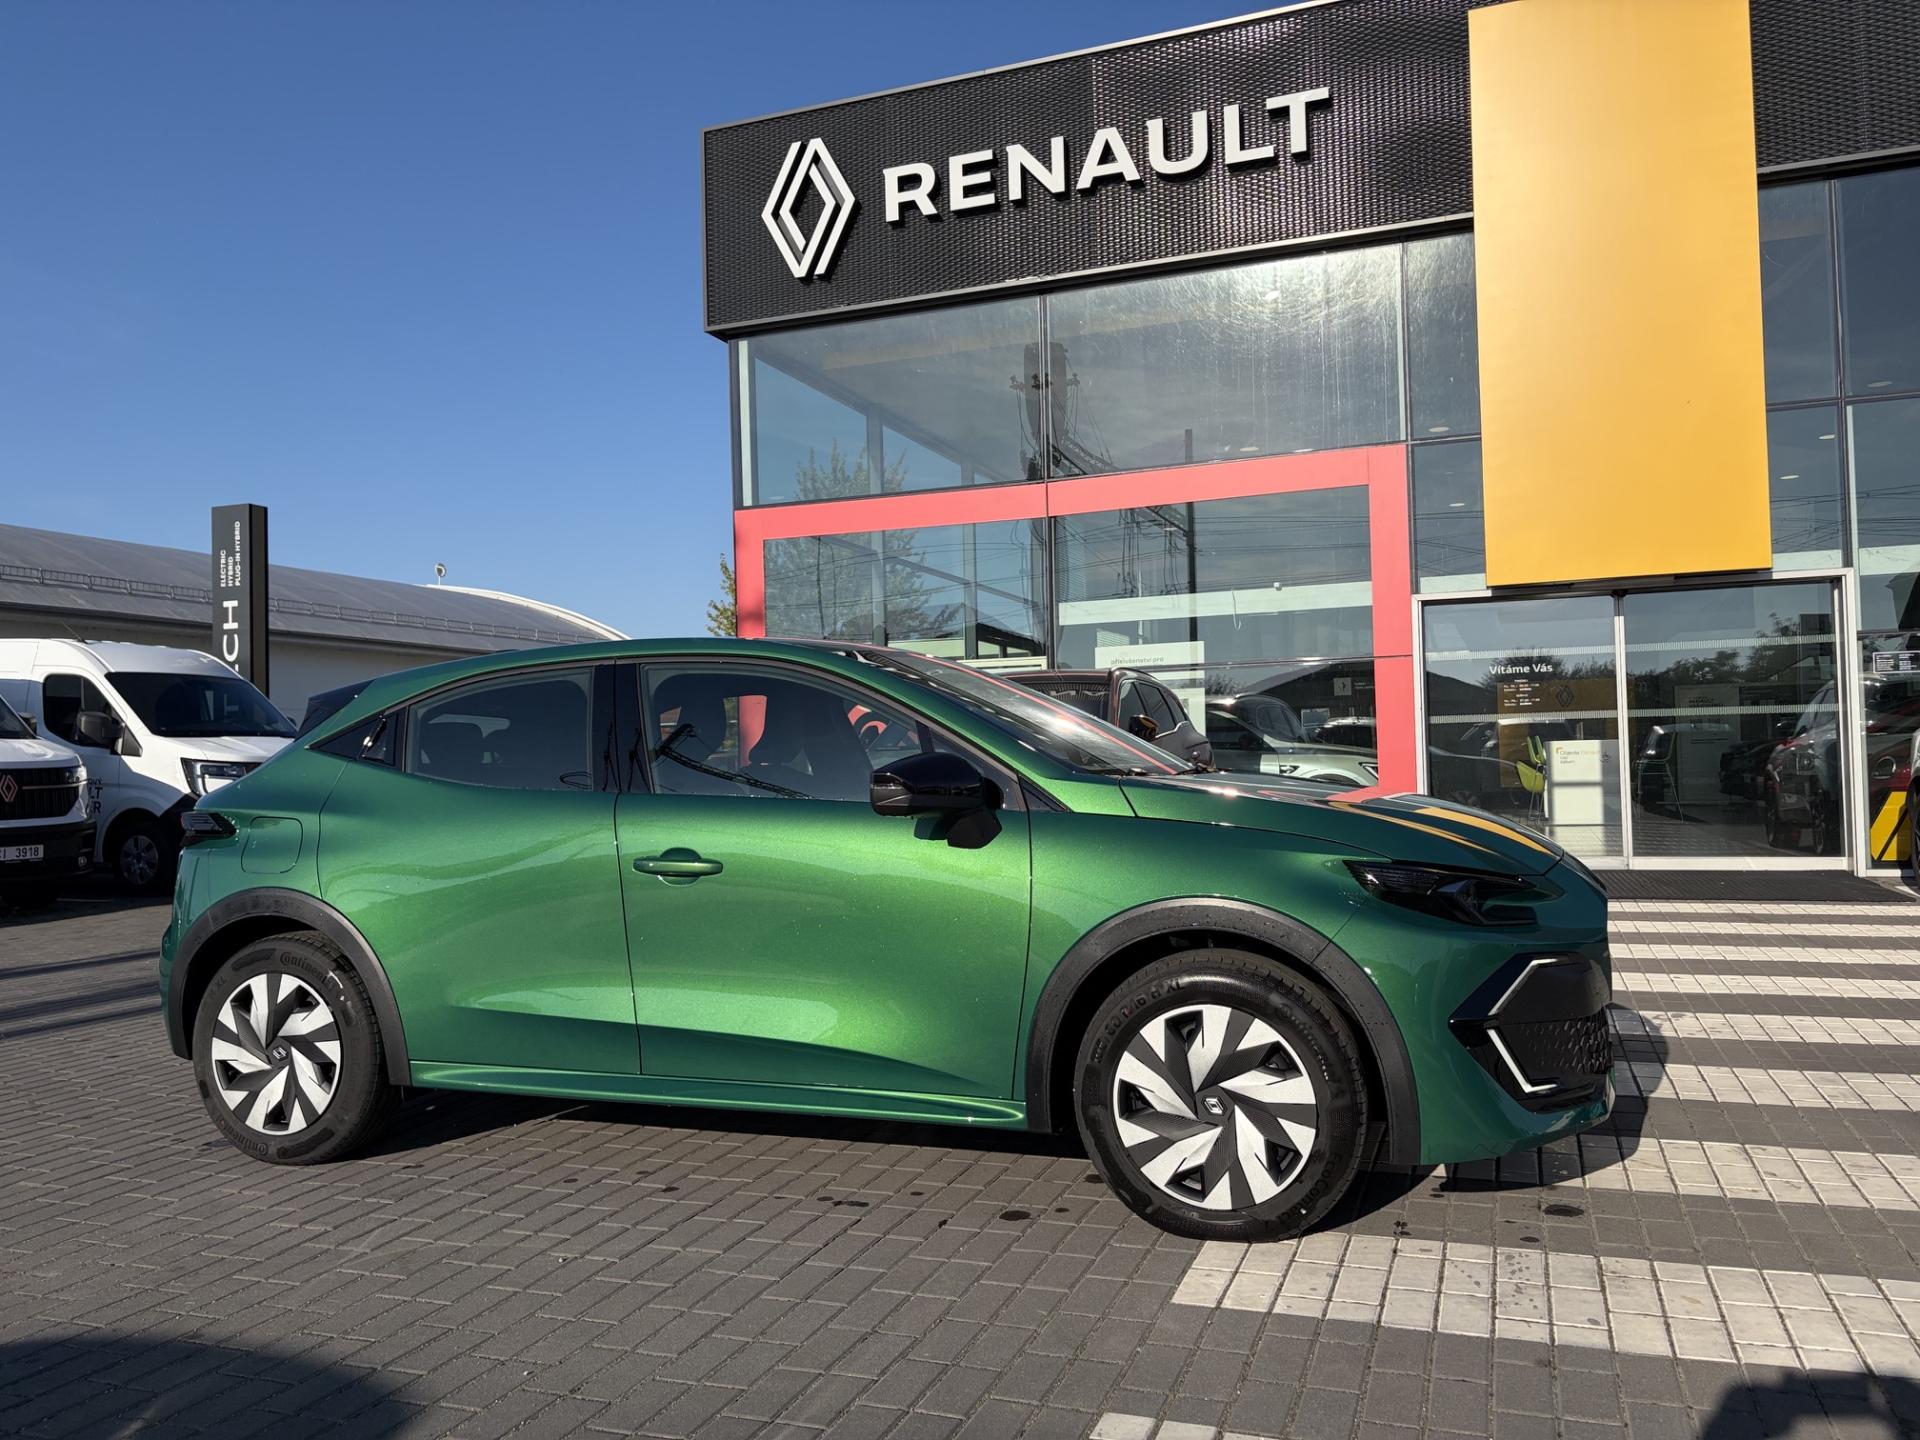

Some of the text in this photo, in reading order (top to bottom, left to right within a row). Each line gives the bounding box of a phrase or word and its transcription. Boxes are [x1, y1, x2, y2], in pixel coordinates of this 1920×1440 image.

[882, 86, 1330, 223] RENAULT
[222, 600, 239, 672] CH
[1489, 662, 1553, 675] Vítáme Vás
[15, 846, 40, 858] 3918
